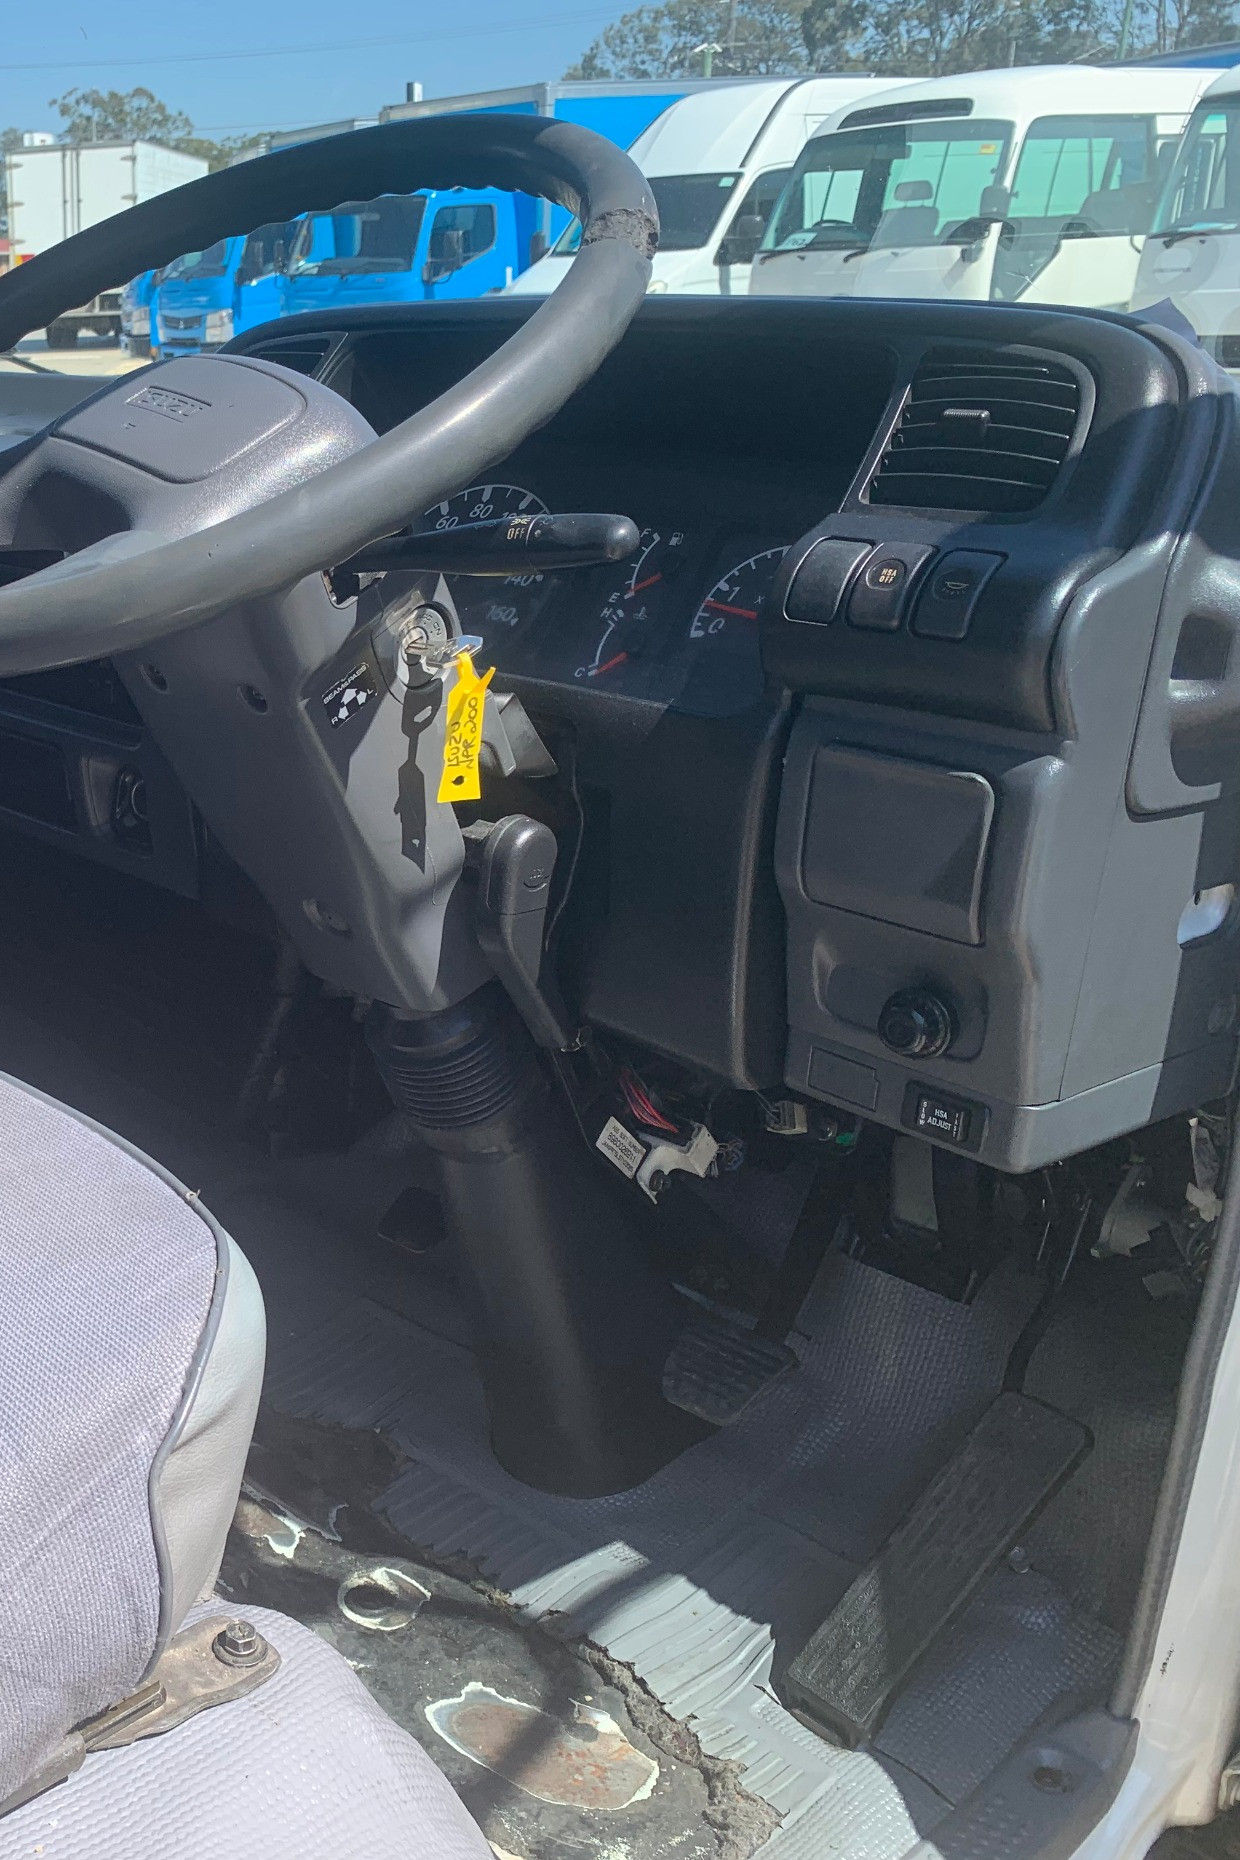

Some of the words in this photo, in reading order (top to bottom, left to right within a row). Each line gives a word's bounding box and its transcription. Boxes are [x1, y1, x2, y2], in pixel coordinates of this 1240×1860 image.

[469, 503, 494, 519] 80
[435, 515, 459, 530] 60
[506, 527, 526, 540] OFF
[640, 528, 652, 538] F
[881, 568, 898, 577] HSA
[503, 574, 535, 587] 140
[878, 575, 895, 584] OFF
[609, 592, 621, 603] E
[727, 586, 741, 602] 1
[485, 605, 517, 622] 160
[600, 607, 611, 618] H
[574, 667, 586, 678] C
[463, 697, 478, 734] 200
[447, 721, 462, 767] ISUZU
[919, 1101, 928, 1126] SLOW
[934, 1108, 948, 1120] HSA
[927, 1116, 952, 1131] ADJUST
